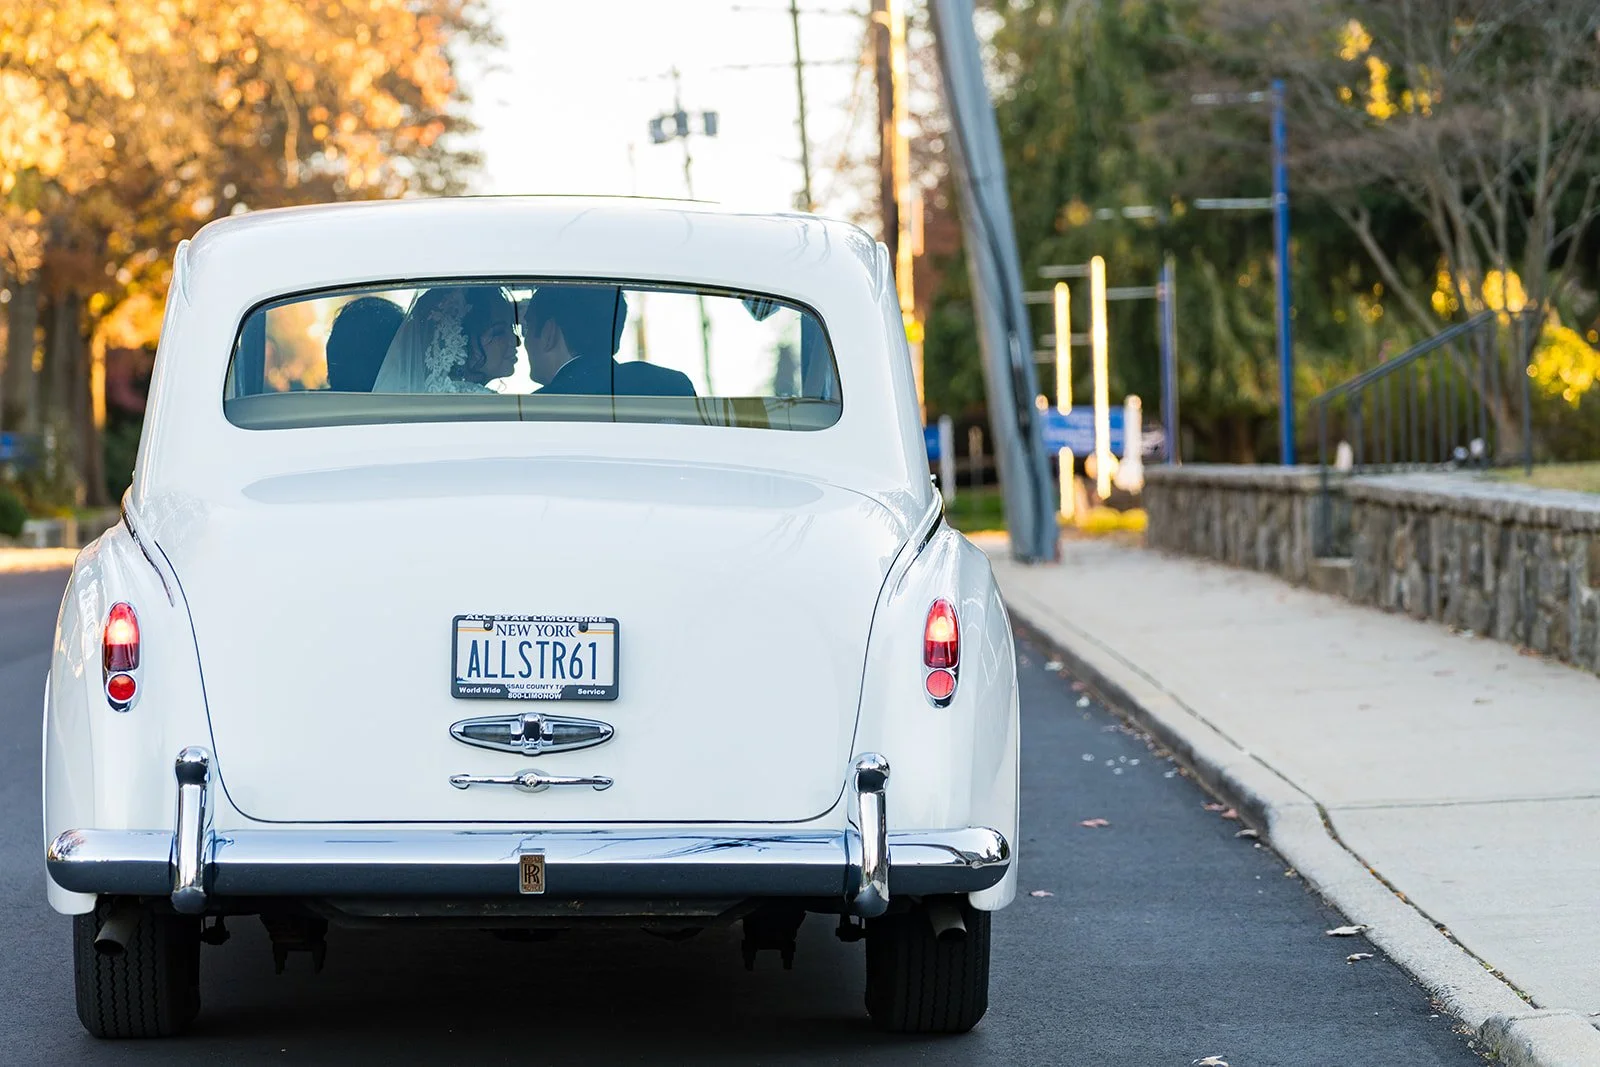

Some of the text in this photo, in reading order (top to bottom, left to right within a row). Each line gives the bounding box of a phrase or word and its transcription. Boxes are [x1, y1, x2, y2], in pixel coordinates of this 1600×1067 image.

[496, 624, 576, 637] NEW YORK
[467, 640, 597, 680] ALLSTR61
